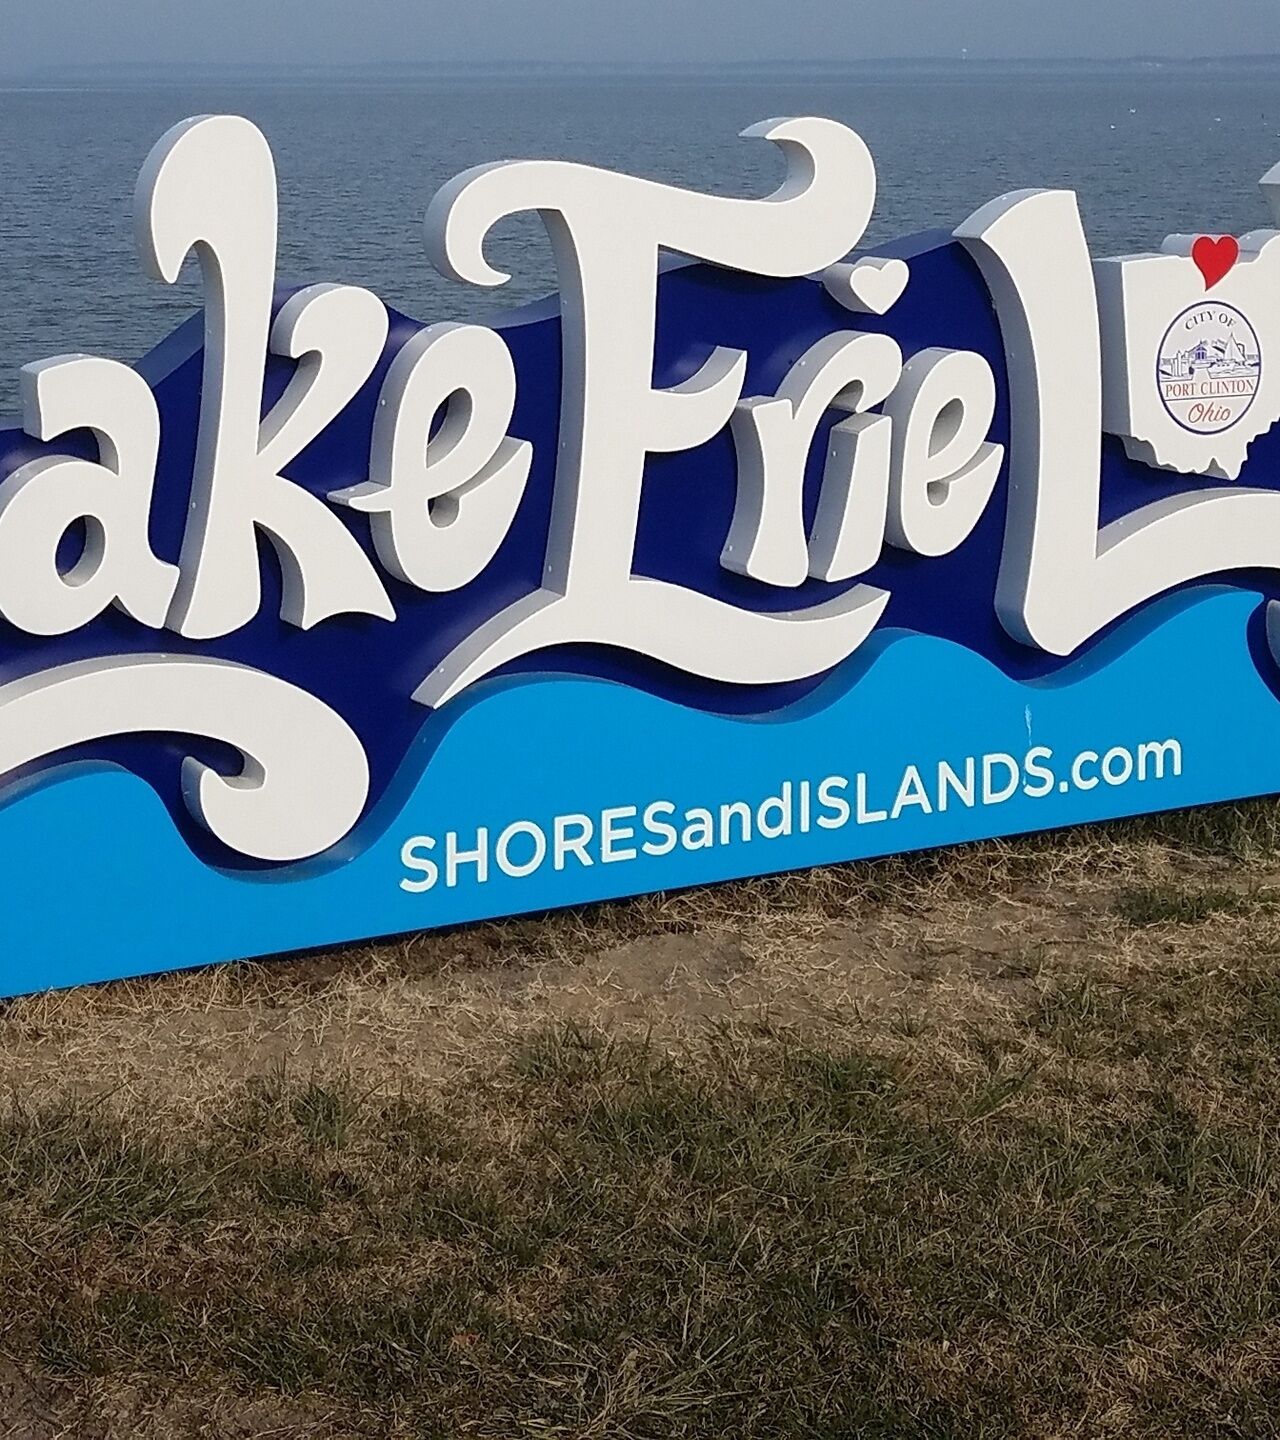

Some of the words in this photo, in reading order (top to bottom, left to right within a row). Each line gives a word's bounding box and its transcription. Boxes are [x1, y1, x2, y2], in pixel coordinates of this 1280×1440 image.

[1184, 310, 1216, 331] CITY
[1218, 311, 1237, 328] OF
[1165, 382, 1197, 398] PORT
[1200, 379, 1254, 395] CLINTON
[412, 116, 1005, 708] Erie
[1187, 401, 1232, 424] Ohio
[398, 736, 1183, 894] SHORESandISLANDS.com
